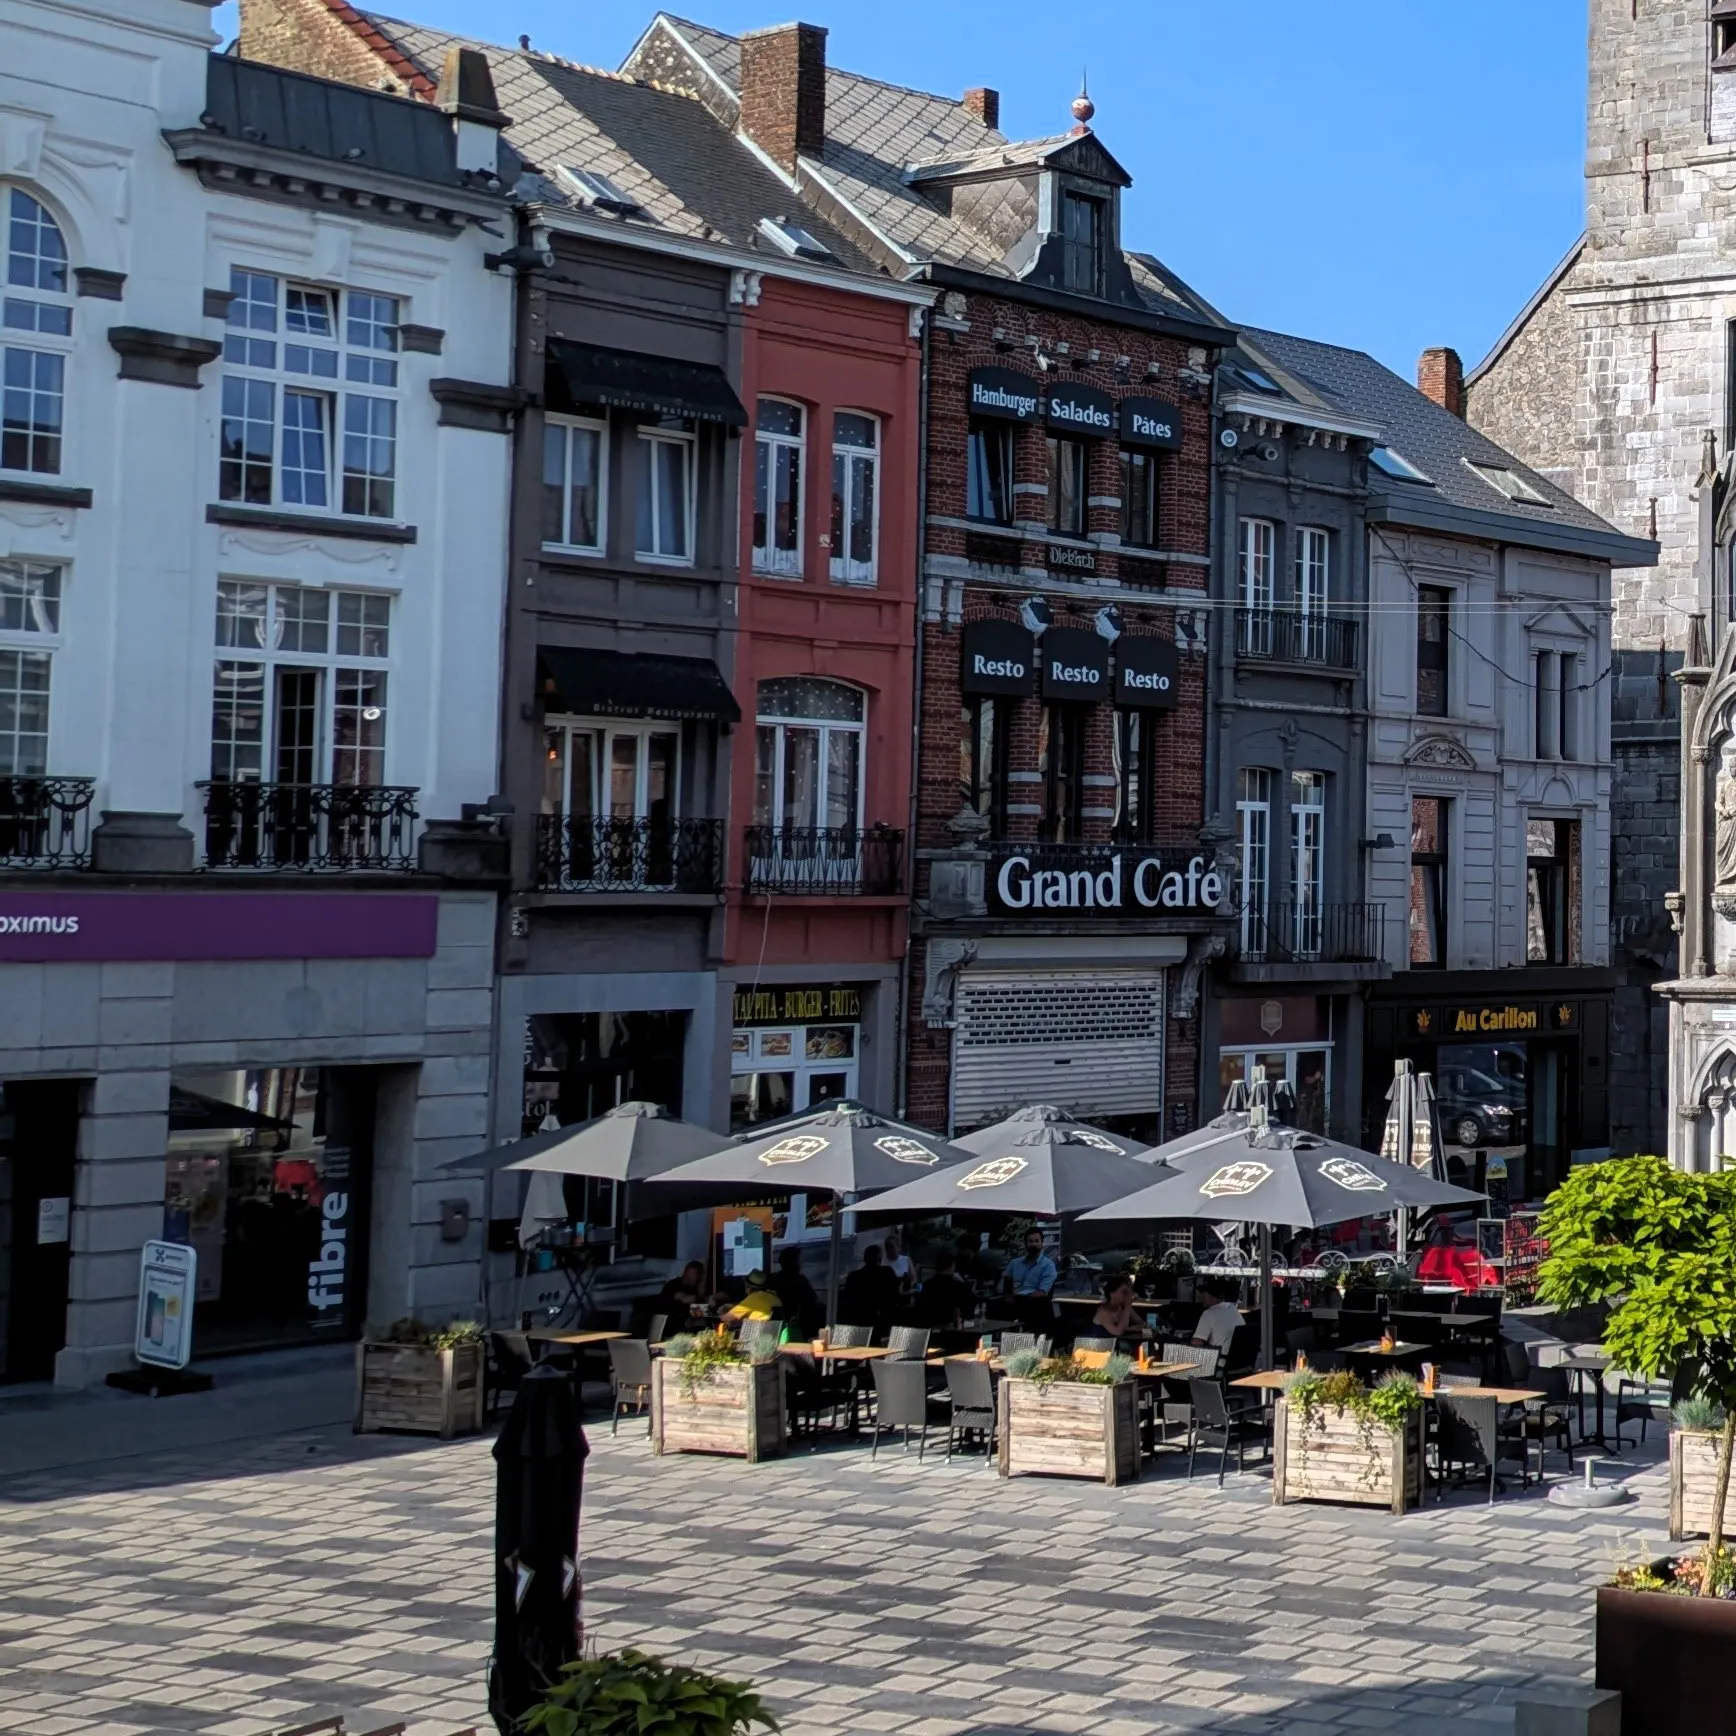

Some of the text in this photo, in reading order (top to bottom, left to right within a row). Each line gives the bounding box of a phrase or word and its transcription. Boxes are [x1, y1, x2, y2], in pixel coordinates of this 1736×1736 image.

[972, 383, 1036, 417] Hamburger
[1051, 398, 1110, 427] Salades
[1133, 414, 1172, 438] Pâtes
[973, 654, 1024, 678] Resto
[1052, 661, 1100, 684] Resto
[1124, 668, 1170, 690] Resto
[997, 854, 1222, 908] Grand Café
[785, 990, 822, 1019] BURGER
[829, 989, 860, 1017] FRITES
[1455, 1006, 1537, 1031] Au Carillon
[308, 1191, 349, 1311] fibre
